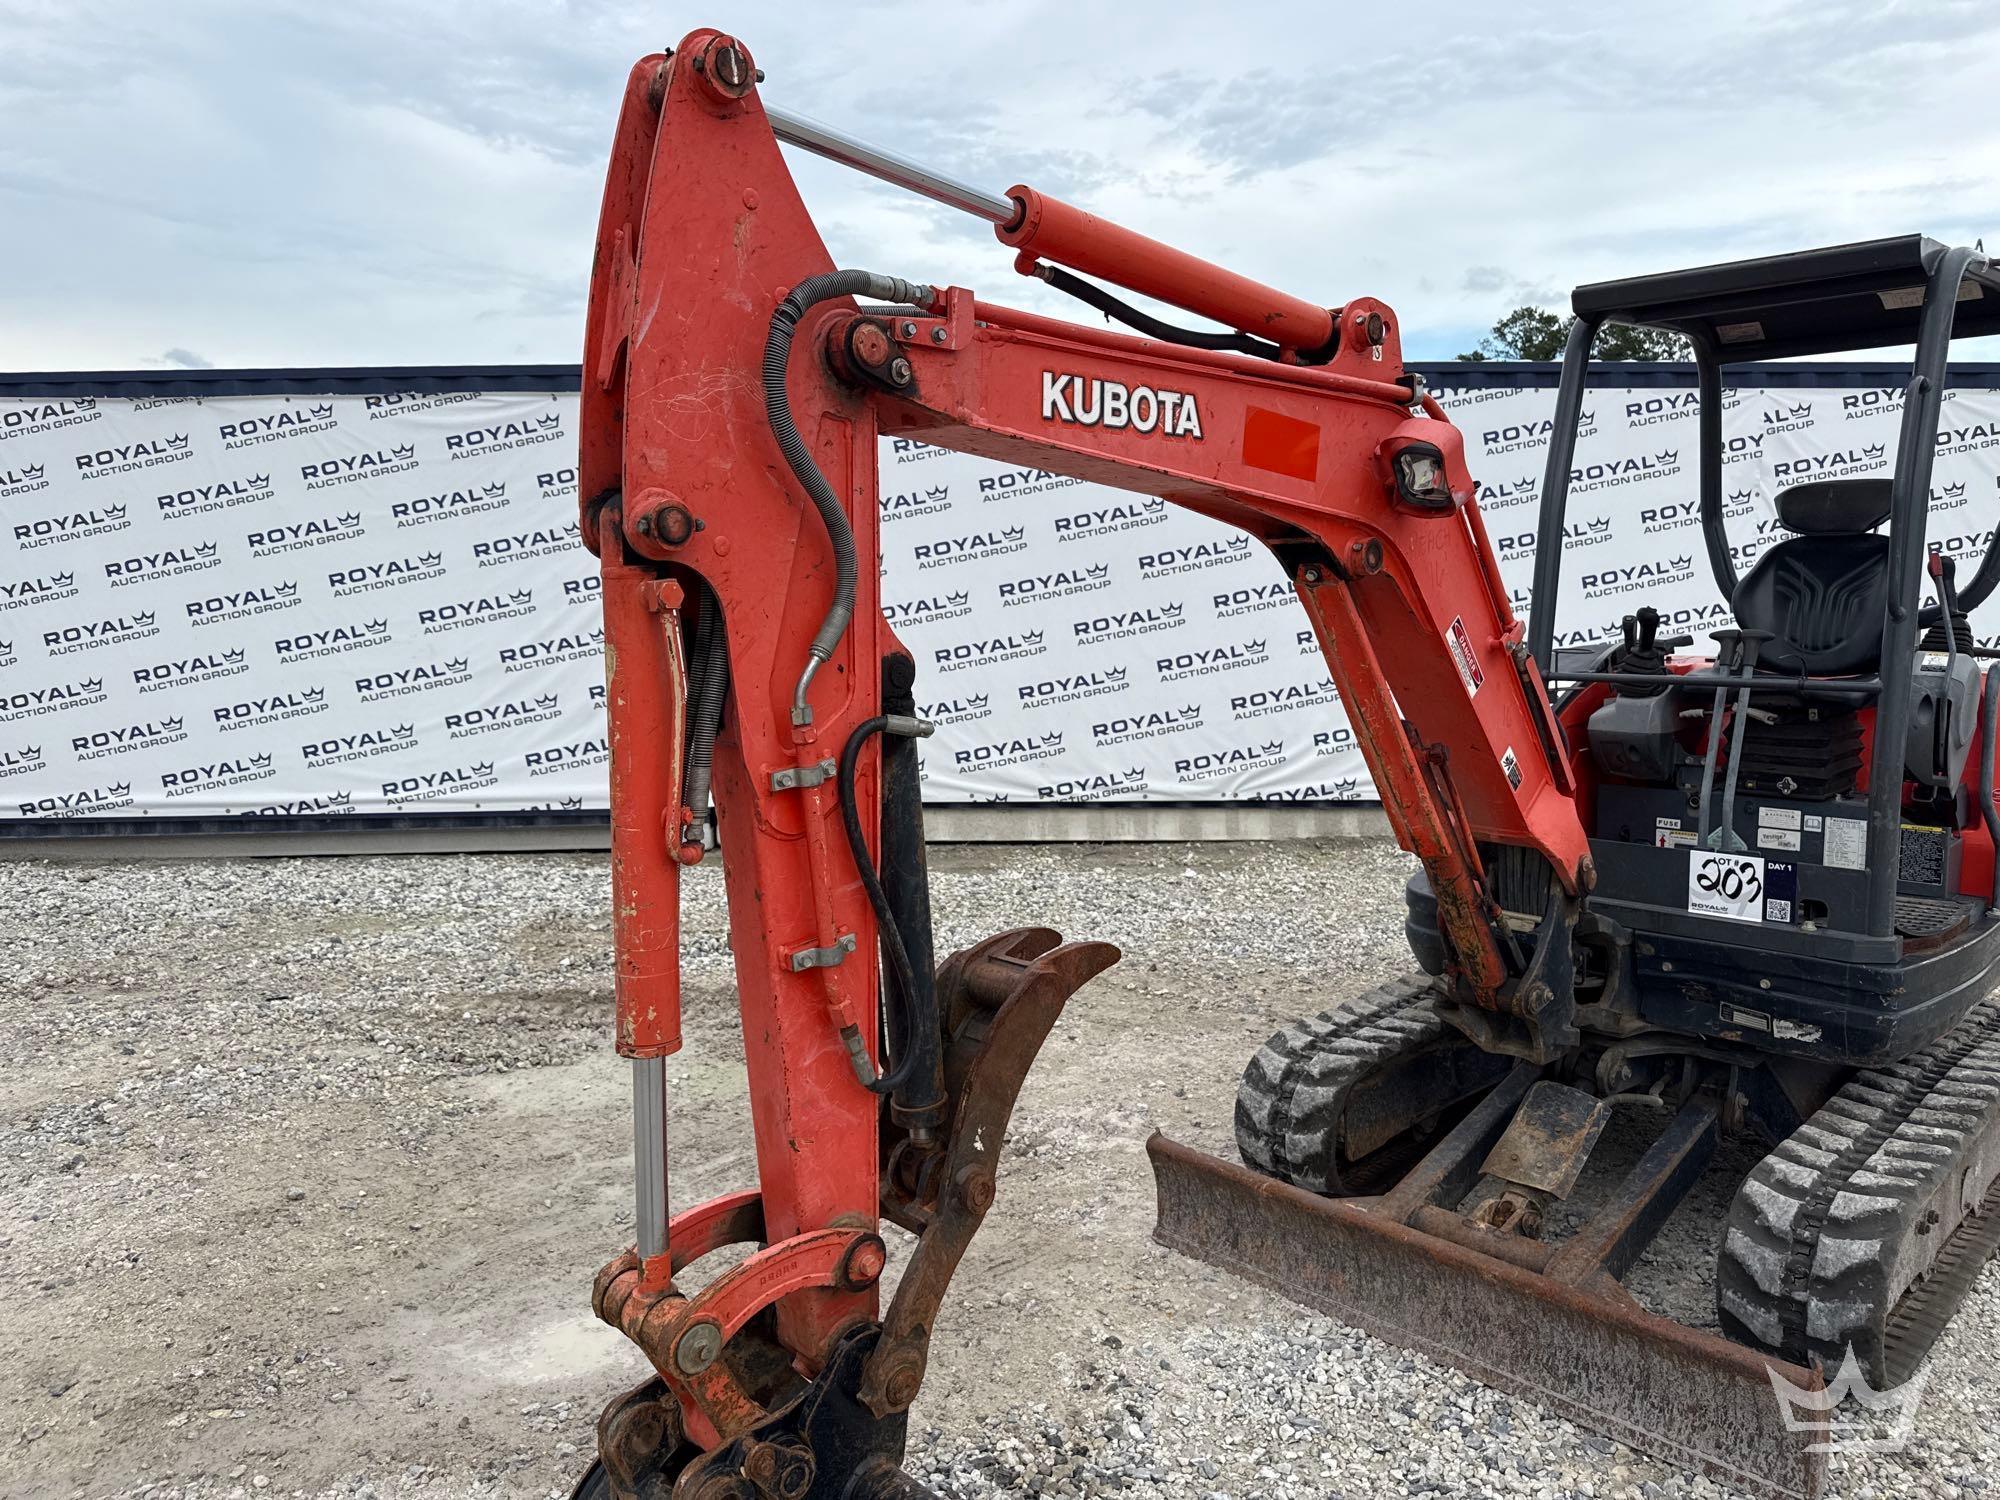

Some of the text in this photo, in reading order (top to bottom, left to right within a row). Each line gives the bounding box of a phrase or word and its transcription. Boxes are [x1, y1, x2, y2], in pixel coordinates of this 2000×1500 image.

[370, 392, 482, 420] AUCTION GROUP
[1042, 371, 1203, 440] KUBOTA
[1475, 387, 1523, 403] GROUP
[53, 412, 102, 428] GROUP
[219, 410, 311, 440] ROYAL
[1629, 410, 1689, 428] AUCTION
[1766, 420, 1814, 435] GROUP
[225, 421, 338, 450] AUCTION GROUP
[446, 420, 538, 450] ROYAL
[451, 431, 564, 461] AUCTION GROUP
[1486, 437, 1547, 456] AUCTION
[75, 440, 167, 470] ROYAL
[82, 451, 193, 480] AUCTION GROUP
[301, 451, 393, 480] ROYAL
[1774, 450, 1862, 478] ROYAL
[307, 461, 419, 491] AUCTION GROUP
[1569, 456, 1656, 483] ROYAL
[1570, 466, 1680, 494] AUCTION GROUP
[1776, 460, 1887, 488] AUCTION GROUP
[1, 481, 49, 497] GROUP
[157, 481, 248, 510] ROYAL
[983, 484, 1043, 503] AUCTION
[1490, 494, 1538, 510] GROUP
[163, 490, 274, 520] AUCTION GROUP
[392, 489, 484, 518] ROYAL
[397, 499, 510, 528] AUCTION GROUP
[904, 503, 952, 518] GROUP
[13, 511, 105, 540] ROYAL
[1054, 504, 1143, 532] ROYAL
[1059, 514, 1168, 543] AUCTION GROUP
[1644, 516, 1703, 534] AUCTION
[20, 521, 131, 550] AUCTION GROUP
[247, 519, 339, 548] ROYAL
[253, 529, 365, 558] AUCTION GROUP
[473, 529, 564, 558] ROYAL
[914, 532, 1002, 560] ROYAL
[1565, 534, 1612, 549] GROUP
[105, 549, 196, 578] ROYAL
[479, 549, 540, 568] AUCTION
[919, 542, 1028, 570] AUCTION GROUP
[1138, 542, 1227, 570] ROYAL
[1142, 552, 1252, 580] AUCTION GROUP
[111, 558, 222, 588] AUCTION GROUP
[328, 559, 420, 588] ROYAL
[334, 568, 446, 598] AUCTION GROUP
[999, 570, 1086, 597] ROYAL
[1582, 562, 1670, 589] ROYAL
[1585, 572, 1694, 599] AUCTION GROUP
[30, 588, 79, 604] GROUP
[186, 588, 276, 617] ROYAL
[1003, 580, 1111, 607] AUCTION GROUP
[192, 598, 302, 627] AUCTION GROUP
[418, 596, 510, 624] ROYAL
[424, 606, 536, 635] AUCTION GROUP
[925, 607, 972, 622] GROUP
[1074, 609, 1161, 636] ROYAL
[1217, 600, 1276, 619] AUCTION
[43, 618, 134, 646] ROYAL
[49, 628, 160, 657] AUCTION GROUP
[275, 626, 366, 654] ROYAL
[1078, 619, 1186, 646] AUCTION GROUP
[280, 635, 392, 664] AUCTION GROUP
[499, 635, 590, 663] ROYAL
[935, 636, 1022, 663] ROYAL
[939, 646, 1047, 673] AUCTION GROUP
[1156, 645, 1244, 672] ROYAL
[1458, 634, 1477, 672] DANGER
[133, 655, 223, 684] ROYAL
[505, 654, 566, 674] AUCTION
[1160, 655, 1269, 682] AUCTION GROUP
[139, 665, 249, 694] AUCTION GROUP
[355, 664, 446, 693] ROYAL
[361, 674, 472, 703] AUCTION GROUP
[1018, 673, 1105, 700] ROYAL
[59, 694, 108, 710] GROUP
[214, 694, 303, 722] ROYAL
[1022, 682, 1130, 710] AUCTION GROUP
[1231, 684, 1318, 711] ROYAL
[219, 704, 329, 732] AUCTION GROUP
[445, 701, 536, 729] ROYAL
[450, 710, 562, 740] AUCTION GROUP
[946, 710, 992, 724] GROUP
[1092, 711, 1179, 738] ROYAL
[1234, 703, 1293, 720] AUCTION
[72, 723, 162, 751] ROYAL
[78, 732, 188, 762] AUCTION GROUP
[302, 730, 392, 759] ROYAL
[1096, 720, 1204, 747] AUCTION GROUP
[307, 740, 418, 769] AUCTION GROUP
[955, 738, 1041, 764] ROYAL
[959, 747, 1066, 774] AUCTION GROUP
[1175, 747, 1261, 774] ROYAL
[0, 761, 46, 778] GROUP
[161, 760, 250, 788] ROYAL
[530, 758, 591, 777] AUCTION
[1178, 756, 1286, 783] AUCTION GROUP
[166, 769, 276, 798] AUCTION GROUP
[382, 768, 472, 796] ROYAL
[387, 778, 498, 807] AUCTION GROUP
[1037, 774, 1123, 799] ROYAL
[1102, 782, 1148, 797] GROUP
[19, 789, 108, 816] ROYAL
[87, 797, 135, 814] GROUP
[1696, 859, 1762, 903] 203
[1691, 902, 1720, 911] ROYAL
